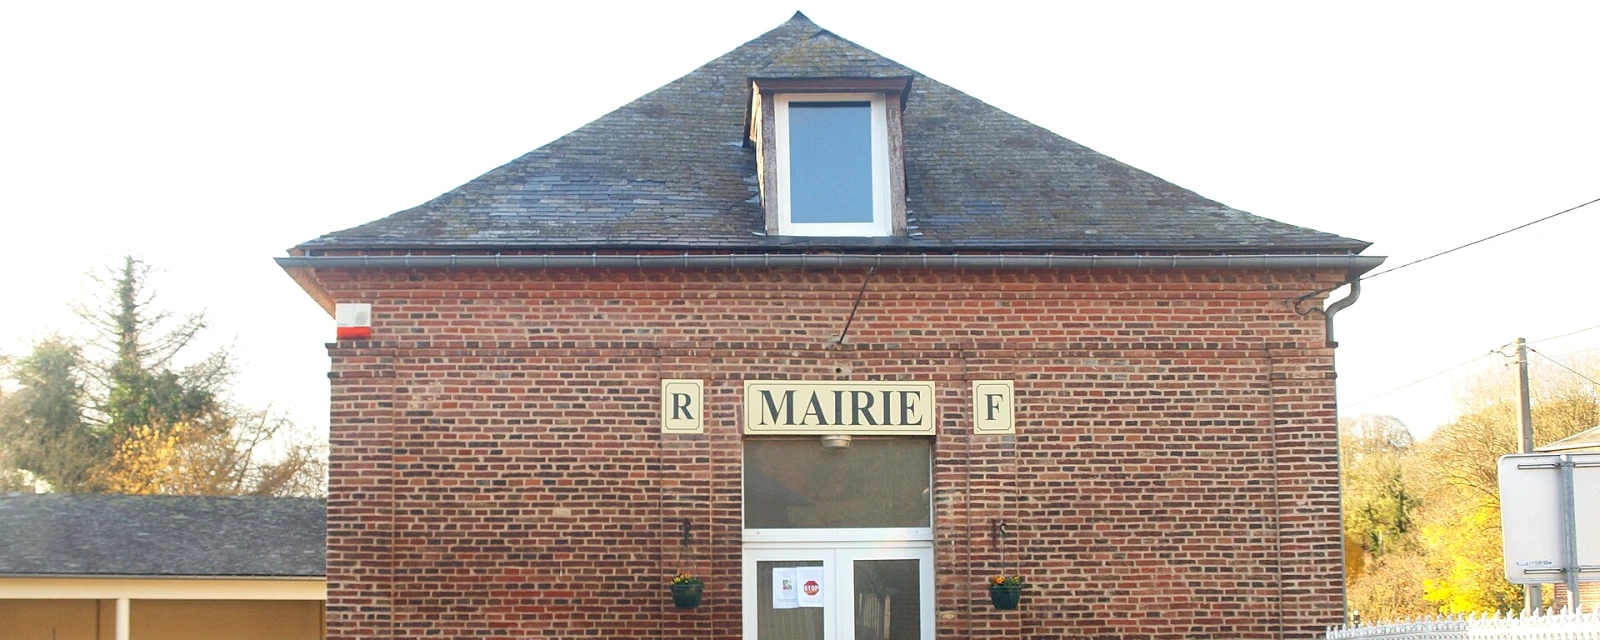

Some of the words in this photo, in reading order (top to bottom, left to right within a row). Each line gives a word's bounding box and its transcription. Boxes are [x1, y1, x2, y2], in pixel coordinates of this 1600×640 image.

[671, 392, 695, 420] R
[758, 389, 923, 426] MAIRIE
[984, 393, 1004, 421] F
